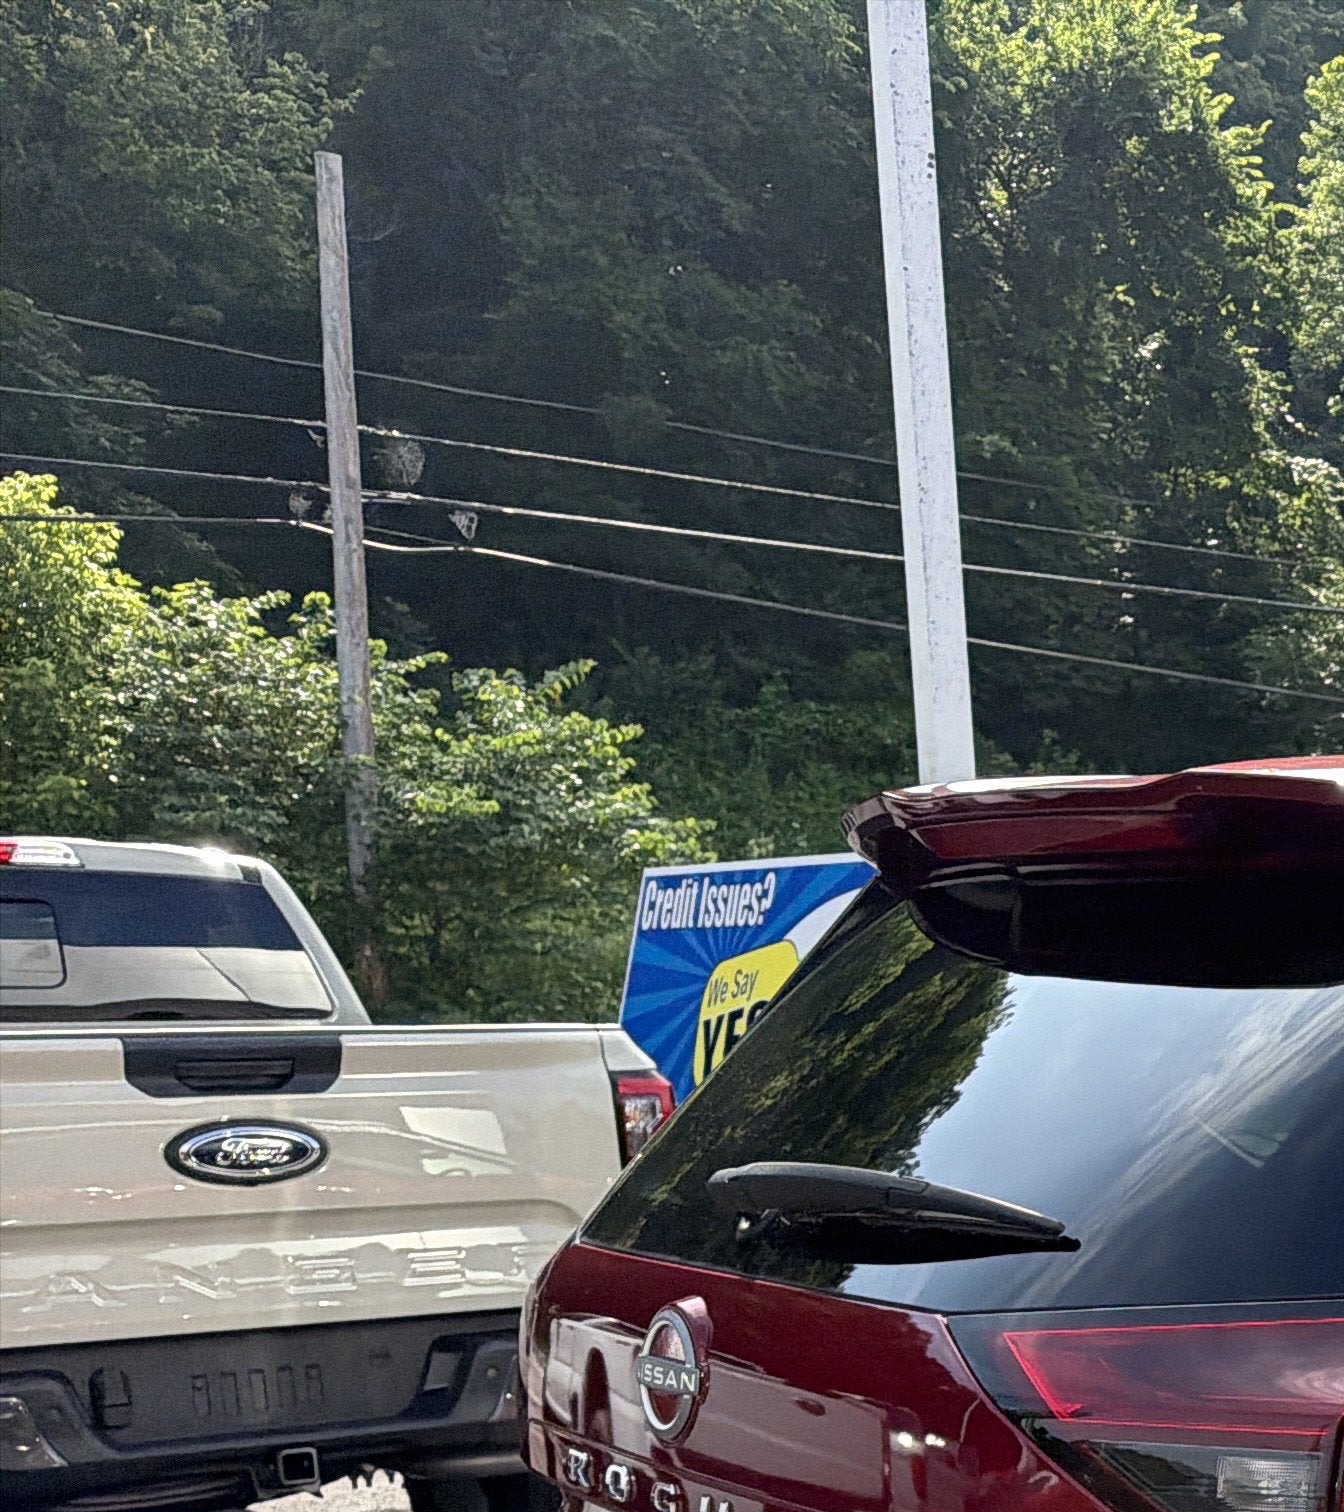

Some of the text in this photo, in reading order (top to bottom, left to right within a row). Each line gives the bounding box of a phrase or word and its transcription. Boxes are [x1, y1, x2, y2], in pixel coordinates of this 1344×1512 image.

[641, 872, 775, 931] Credit Issues?
[707, 969, 758, 1008] We Say
